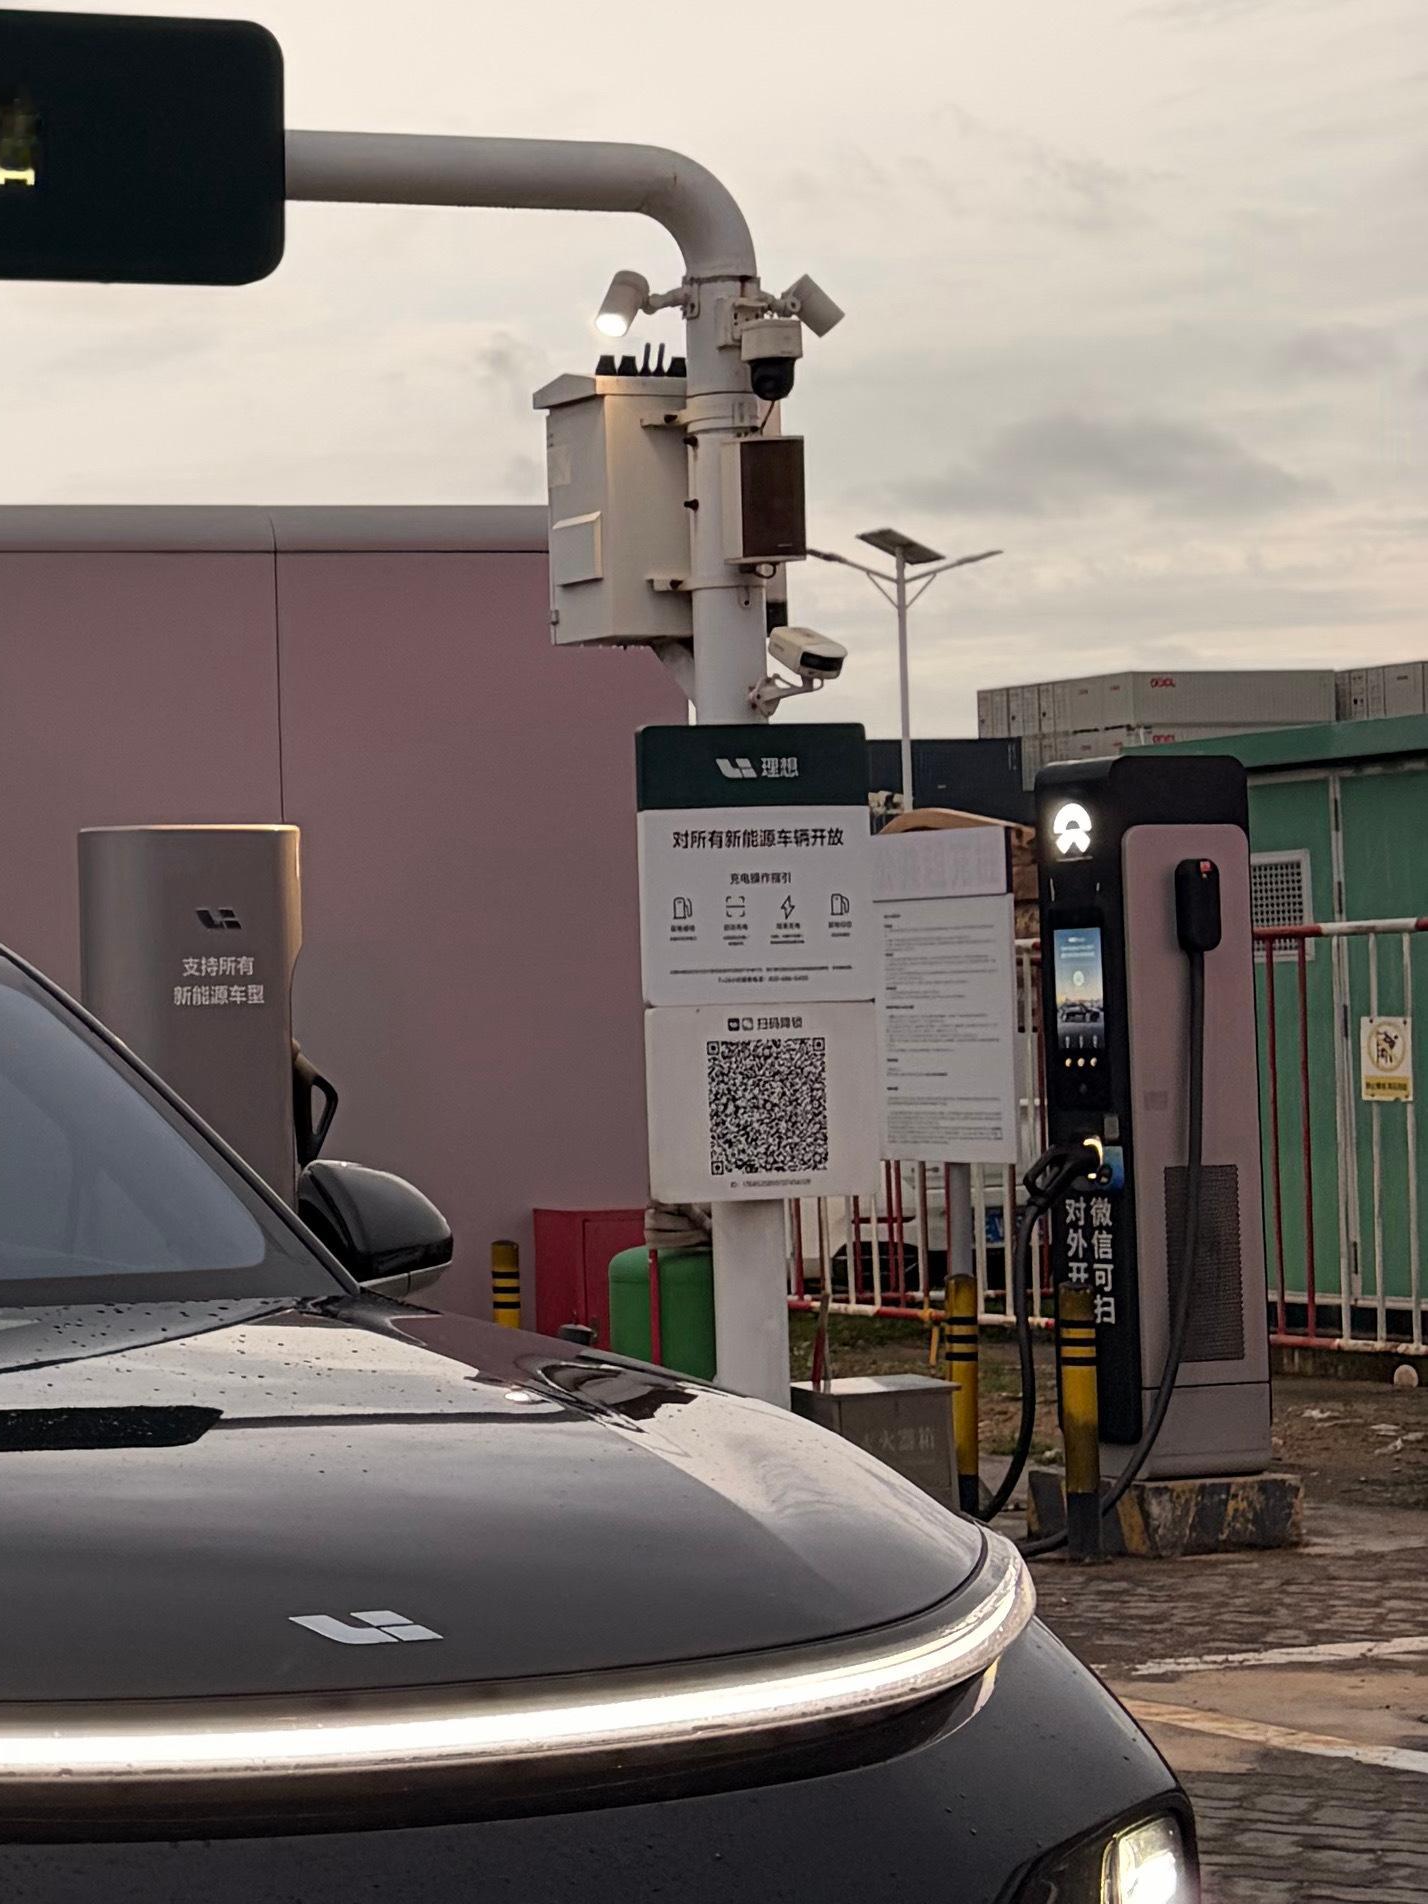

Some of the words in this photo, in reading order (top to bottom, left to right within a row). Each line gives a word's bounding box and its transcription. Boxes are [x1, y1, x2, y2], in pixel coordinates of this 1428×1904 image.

[761, 756, 799, 779] 理想
[672, 828, 844, 849] 对所有新能源车辆开放
[181, 956, 255, 977] 支持所有
[173, 983, 266, 1006] 新能源车型
